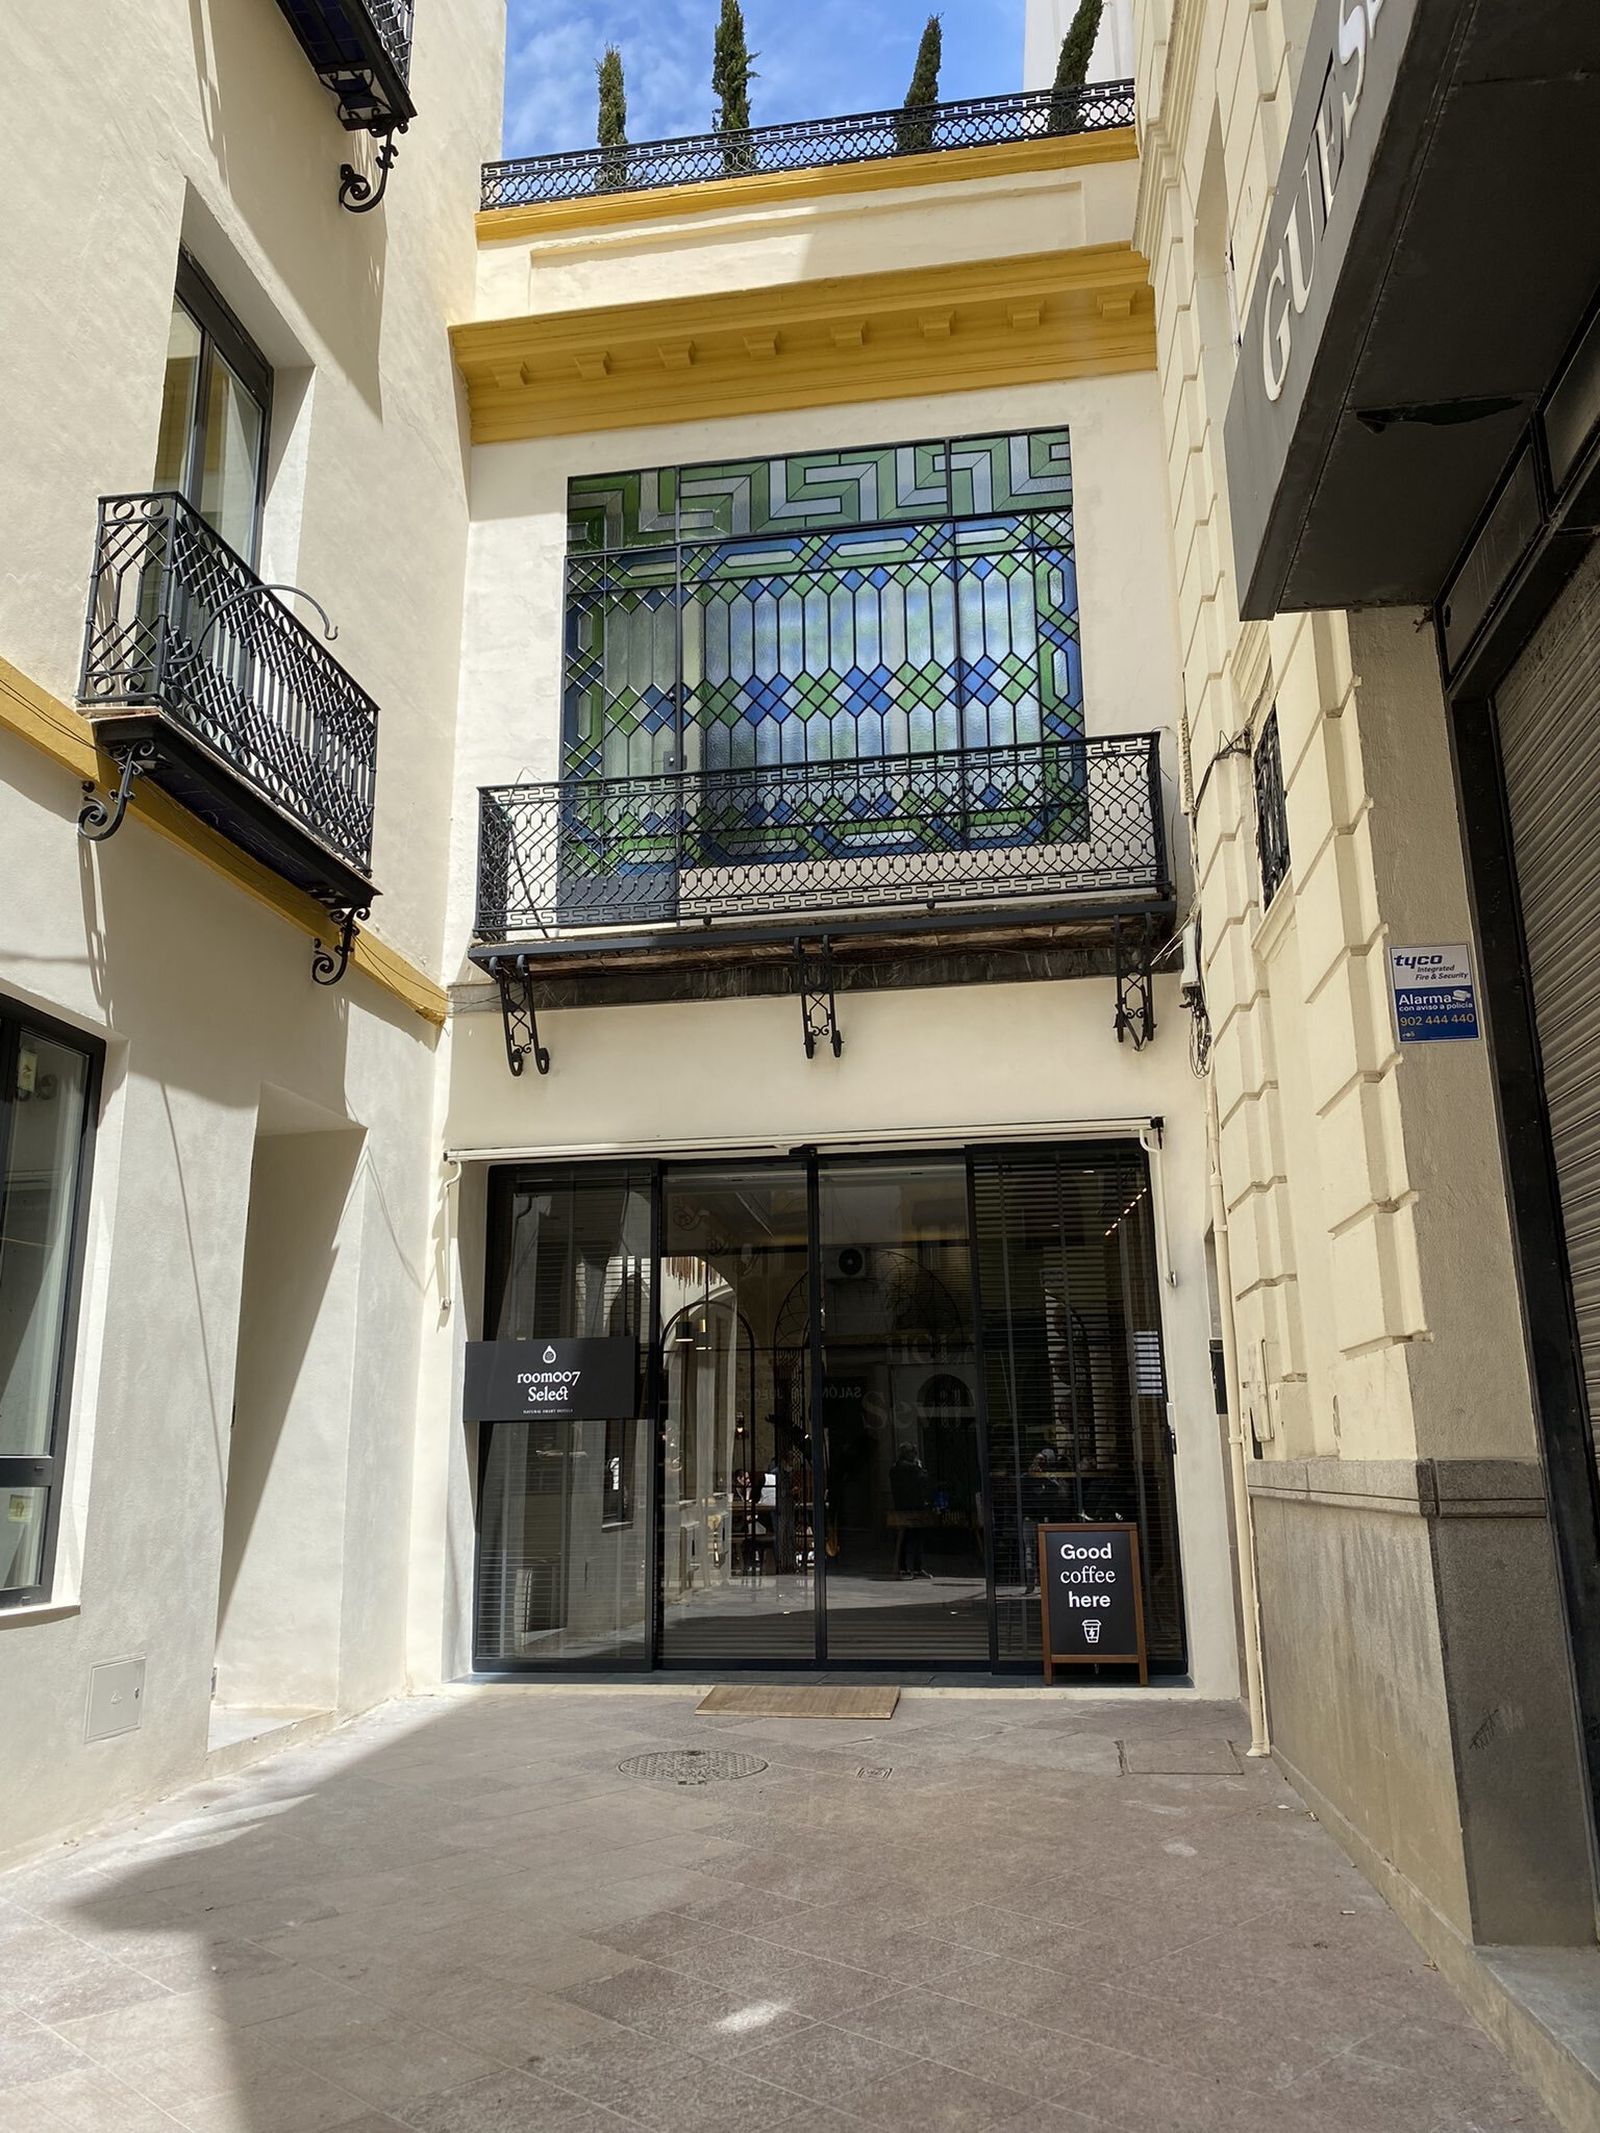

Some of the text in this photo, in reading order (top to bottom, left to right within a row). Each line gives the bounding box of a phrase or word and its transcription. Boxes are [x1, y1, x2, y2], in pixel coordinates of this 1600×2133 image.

[1393, 954, 1443, 969] tyco
[1417, 964, 1455, 973] Integrated
[1438, 972, 1469, 980] Security
[1399, 994, 1452, 1006] Alarma
[1400, 1013, 1475, 1027] 902 444 440
[518, 1371, 581, 1387] room007
[528, 1385, 569, 1402] Select
[1060, 1542, 1112, 1559] Good
[1060, 1566, 1116, 1583] coffee
[1068, 1591, 1111, 1608] here
